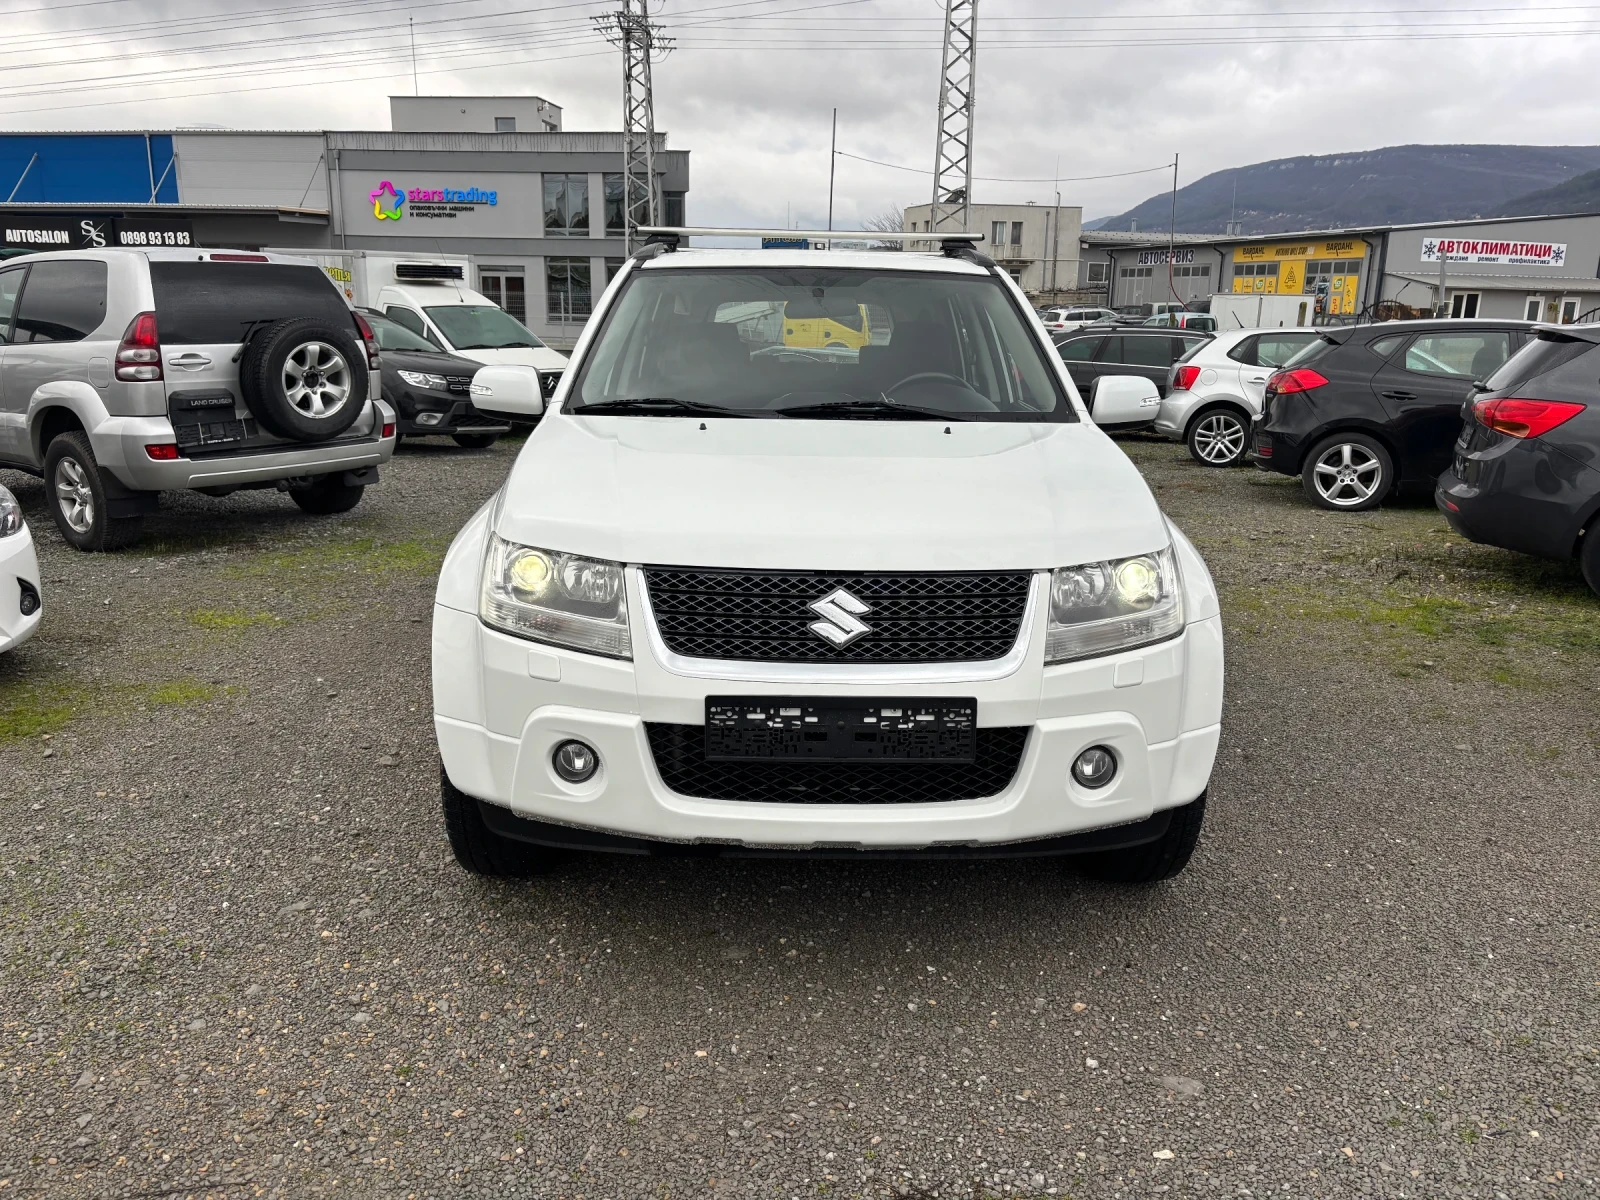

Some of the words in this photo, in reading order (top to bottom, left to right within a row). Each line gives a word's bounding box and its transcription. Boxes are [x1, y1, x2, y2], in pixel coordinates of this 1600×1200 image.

[408, 187, 497, 205] starstrading
[5, 229, 70, 244] AUTOSALON
[120, 231, 147, 245] 0898
[148, 232, 162, 245] 93
[163, 232, 177, 245] 13
[177, 232, 190, 245] 83
[1437, 240, 1553, 258] АВТОКЛИМАТИЦИ
[1138, 250, 1195, 264] АВТОСЕРВИЗ
